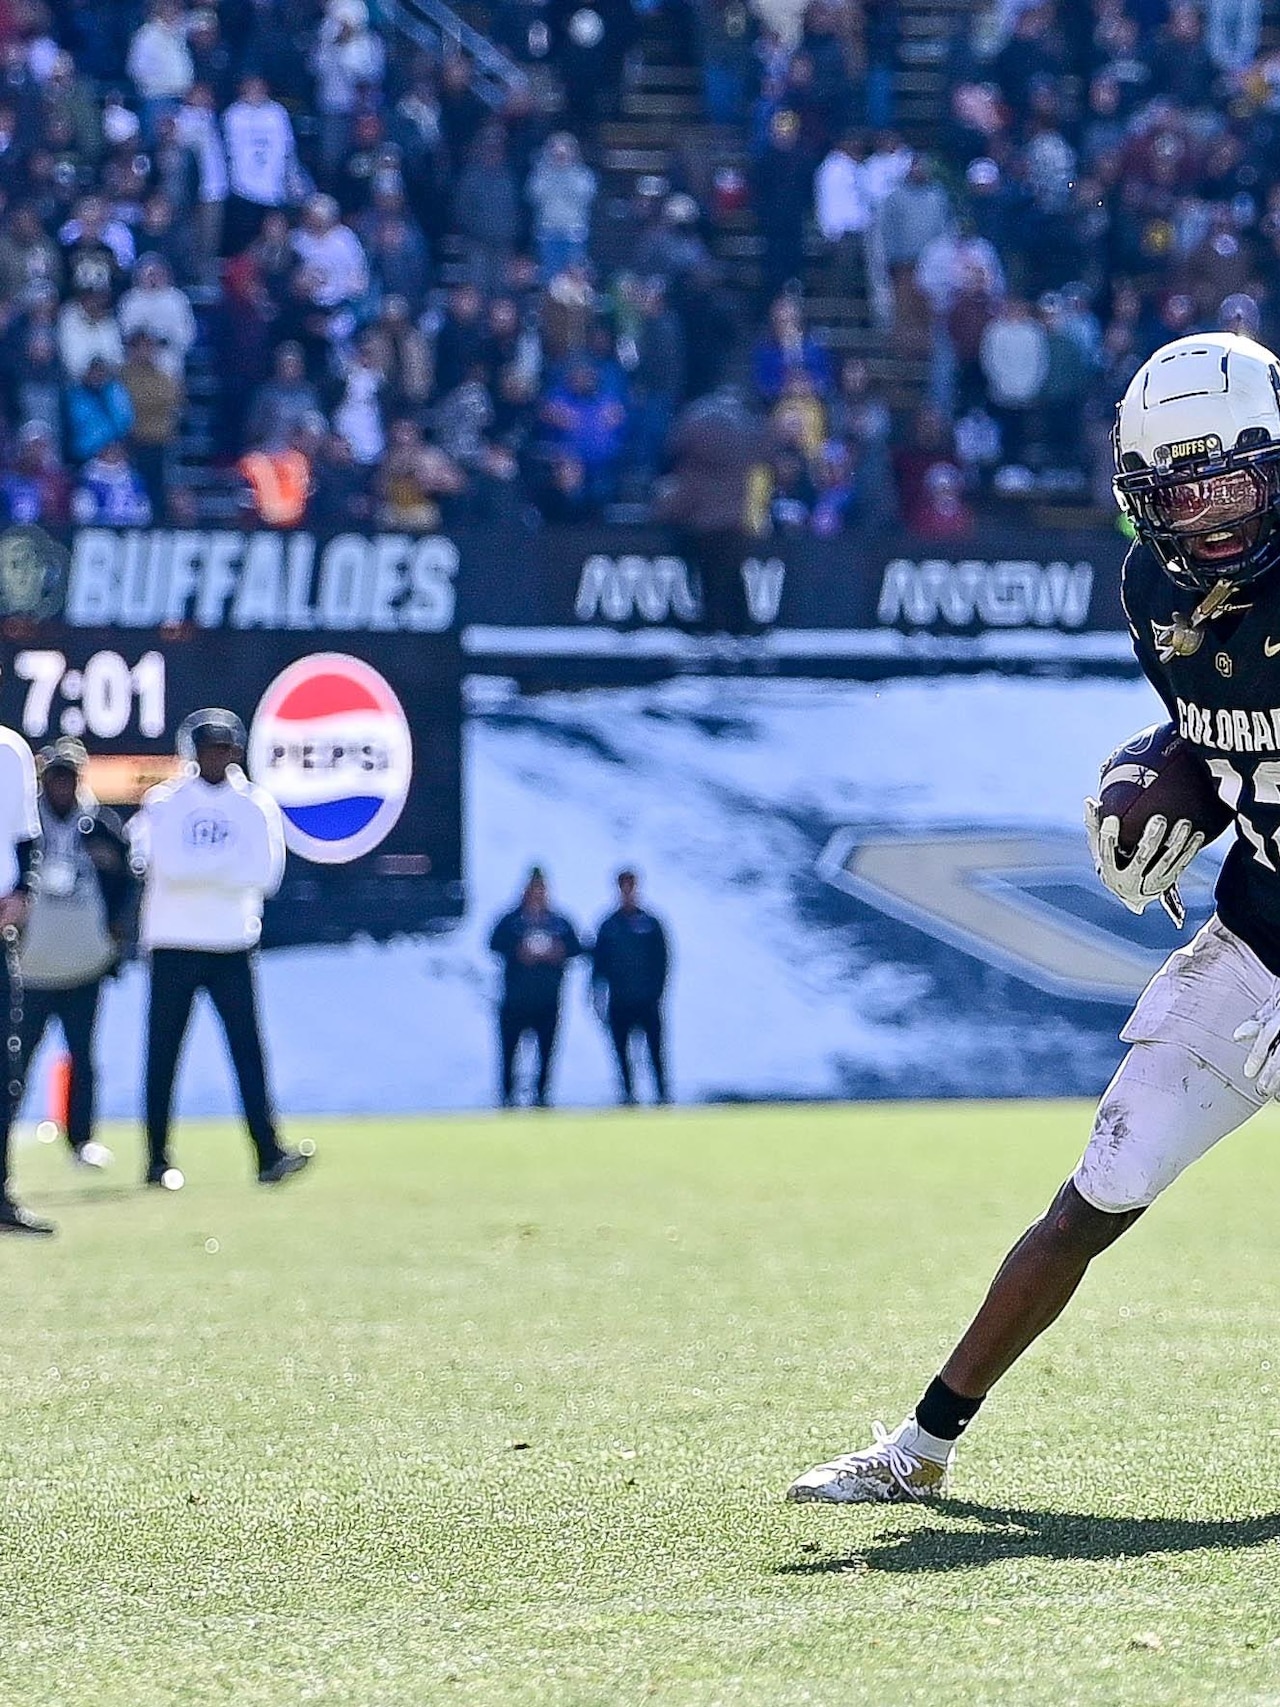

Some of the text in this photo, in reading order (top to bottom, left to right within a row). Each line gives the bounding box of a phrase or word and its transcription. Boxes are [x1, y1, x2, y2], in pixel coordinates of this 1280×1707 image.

[1171, 440, 1206, 459] BUFFS
[65, 528, 460, 632] BUFFALOES
[575, 554, 786, 624] ARRW
[877, 558, 1094, 625] ARROW
[14, 650, 166, 738] 7:01
